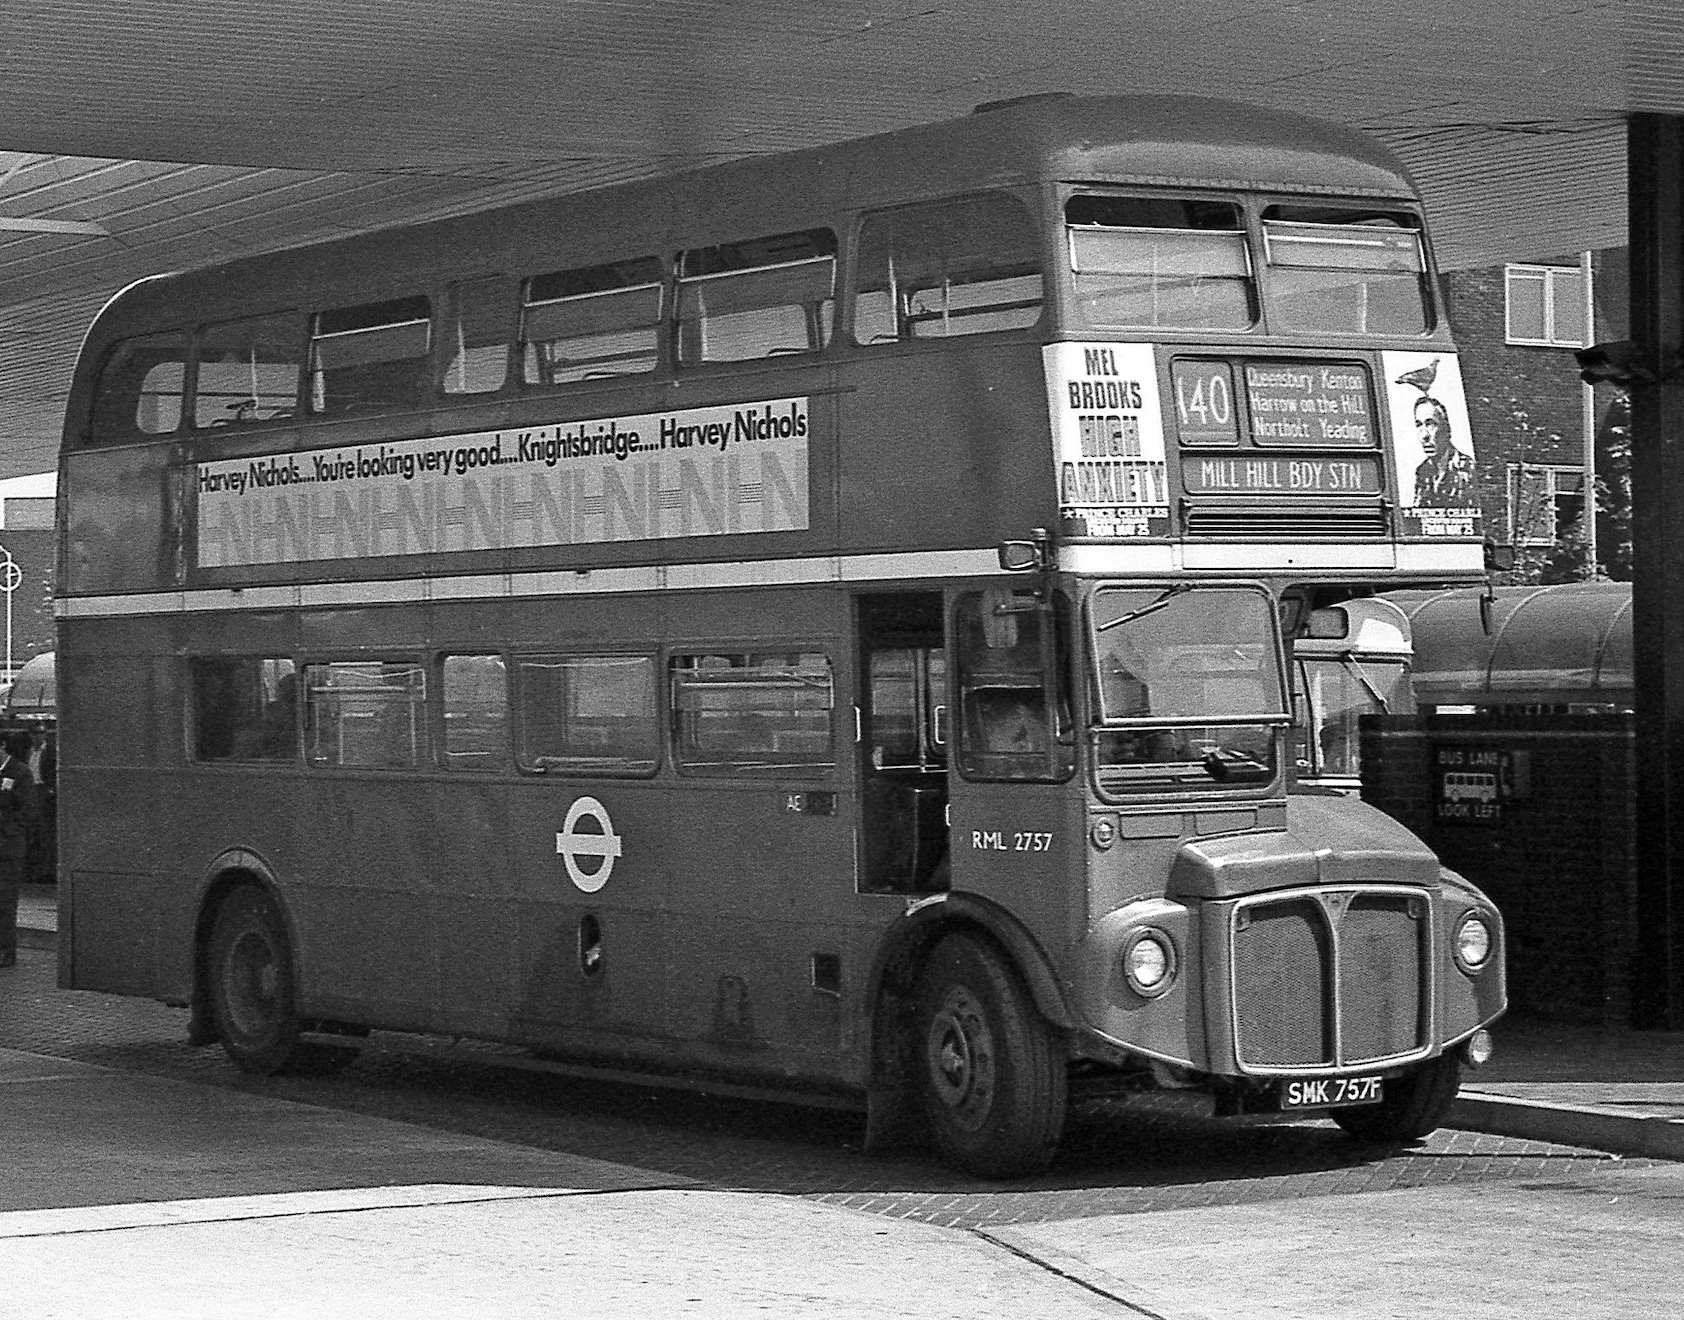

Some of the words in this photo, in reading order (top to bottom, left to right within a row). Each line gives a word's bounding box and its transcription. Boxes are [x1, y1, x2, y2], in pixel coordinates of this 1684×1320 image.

[1085, 348, 1119, 376] MEL
[1068, 380, 1143, 409] BROOKS
[1247, 367, 1313, 394] Queensbury
[1178, 375, 1229, 425] 140
[1250, 390, 1297, 413] Harrow
[1301, 399, 1317, 413] on
[1318, 393, 1339, 414] the
[1341, 394, 1367, 415] Hill
[1078, 415, 1142, 458] HIGH
[1319, 418, 1367, 444] Yeading
[199, 467, 248, 496] Harvey
[356, 446, 415, 480] looking
[416, 449, 453, 476] very
[661, 418, 732, 452] Harvey
[734, 402, 807, 443] Nichols
[1061, 461, 1166, 504] ANXIETY
[1201, 461, 1240, 488] MILL
[1246, 462, 1283, 488] HILL
[1289, 461, 1323, 489] BDY
[1329, 463, 1362, 490] STN
[1439, 751, 1463, 765] BUS
[1469, 752, 1499, 766] LANE
[1438, 803, 1470, 818] LOOK
[1475, 804, 1502, 818] LEFT
[972, 830, 1007, 850] RML
[1014, 832, 1053, 851] 2757
[1288, 1079, 1330, 1105] SMK
[1334, 1075, 1383, 1102] 757F
